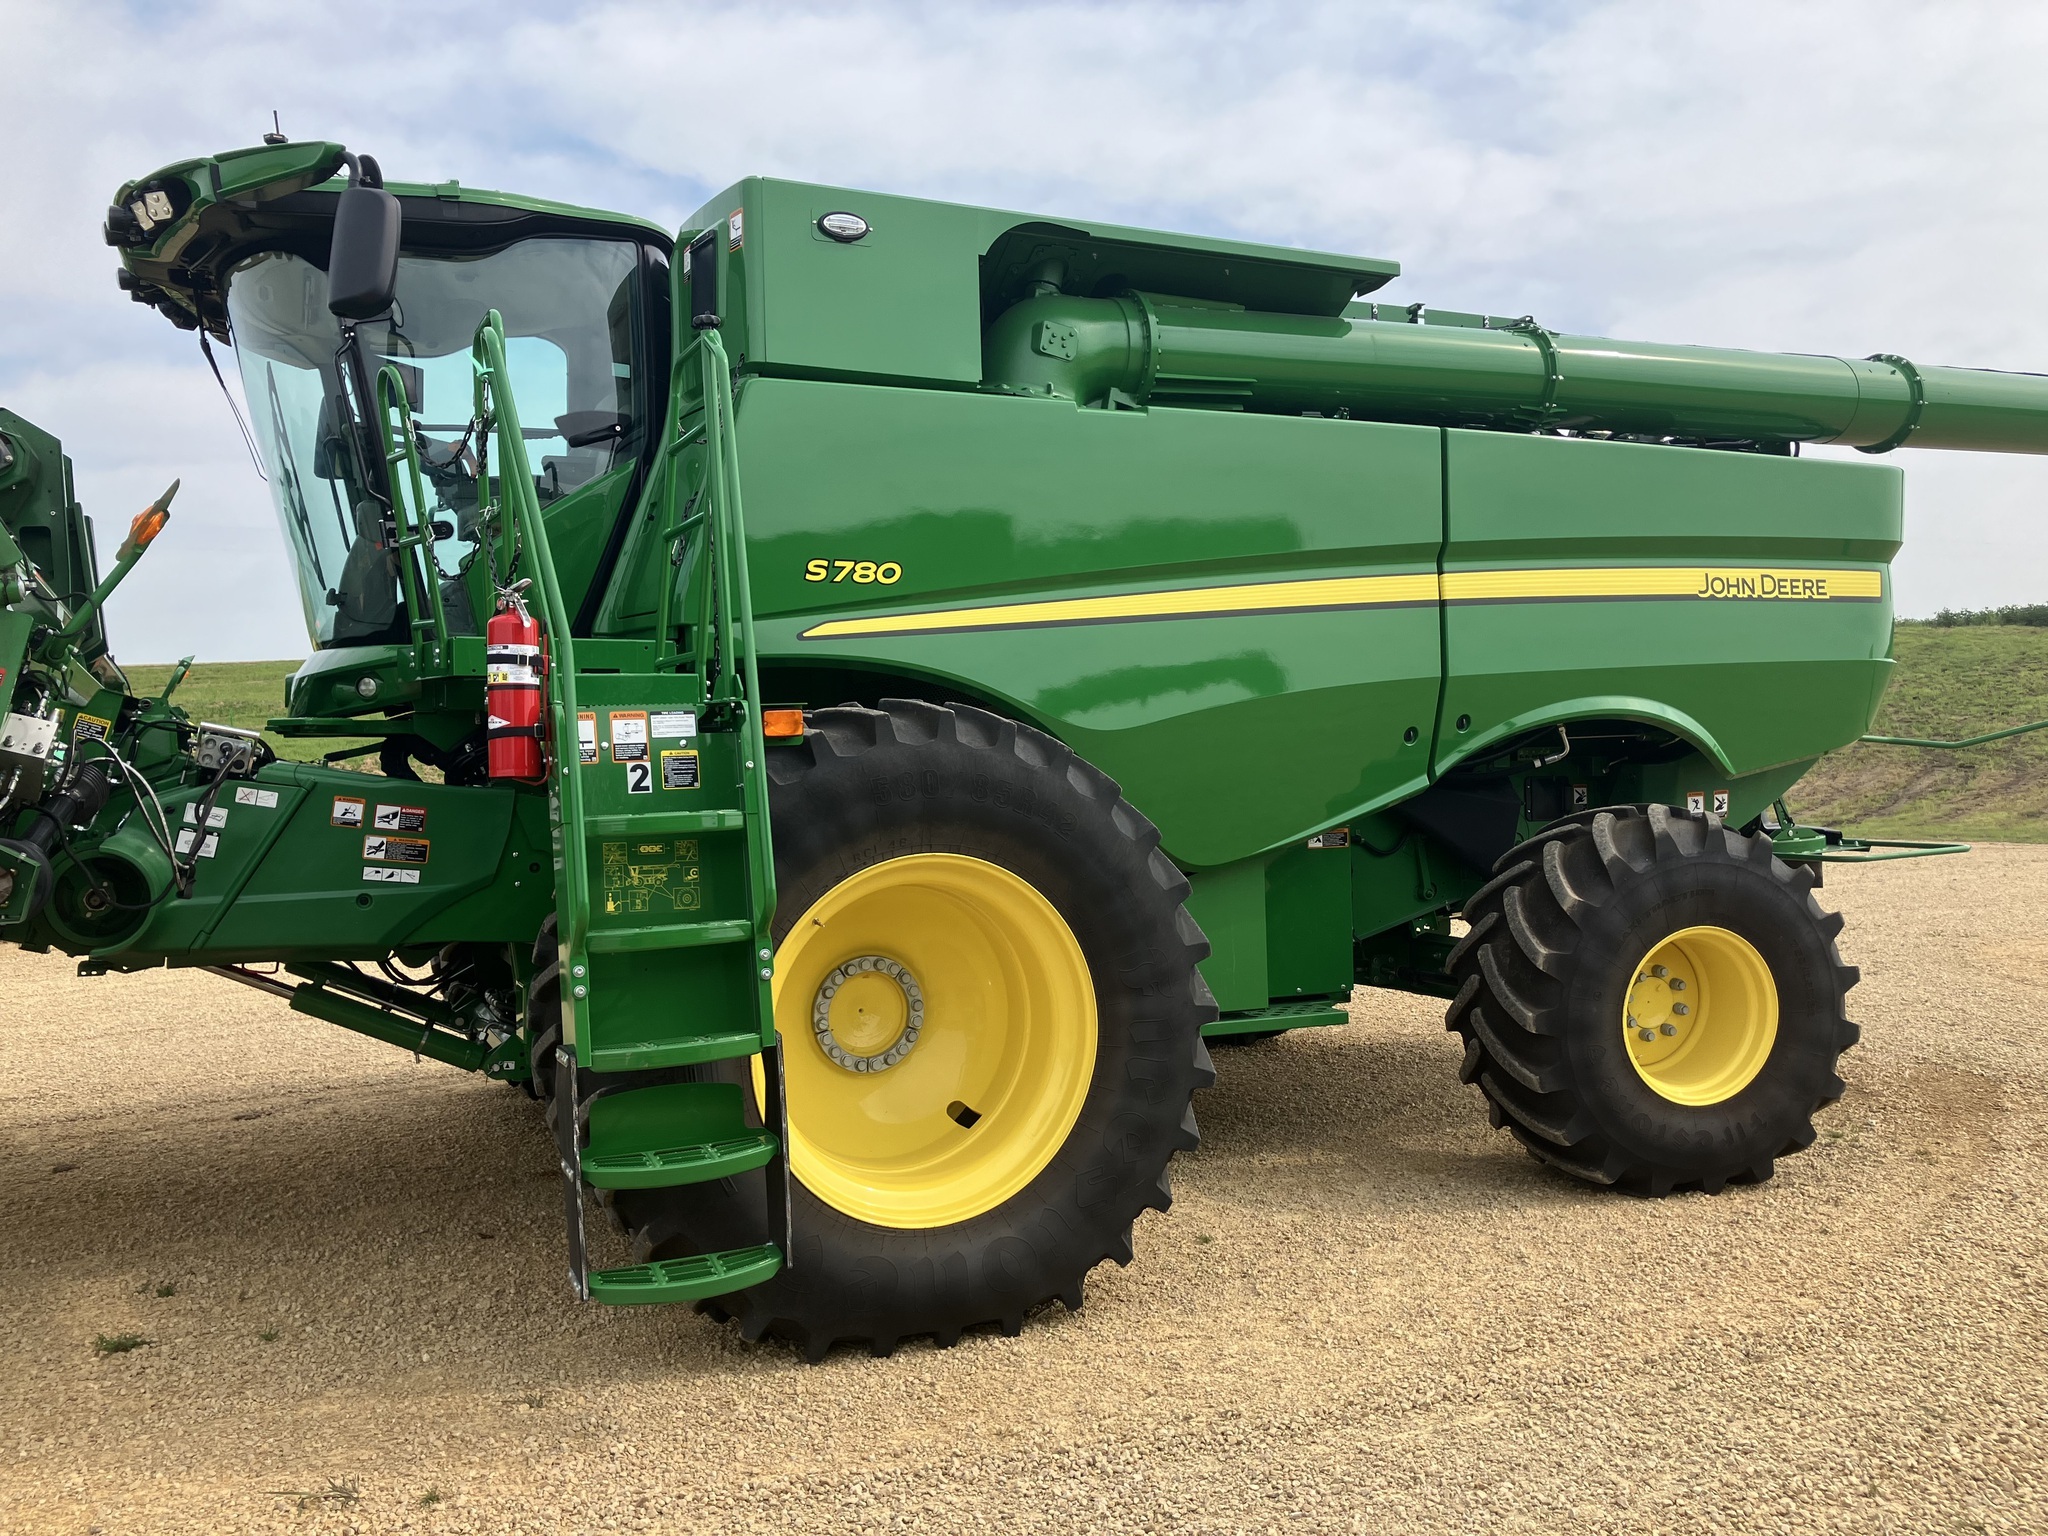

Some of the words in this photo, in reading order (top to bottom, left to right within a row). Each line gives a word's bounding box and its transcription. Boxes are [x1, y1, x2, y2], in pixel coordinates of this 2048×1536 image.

[803, 558, 904, 585] S780
[1698, 573, 1756, 595] JOHN
[1760, 574, 1828, 597] DEERE
[83, 715, 109, 726] CAUTION
[630, 764, 649, 791] 2
